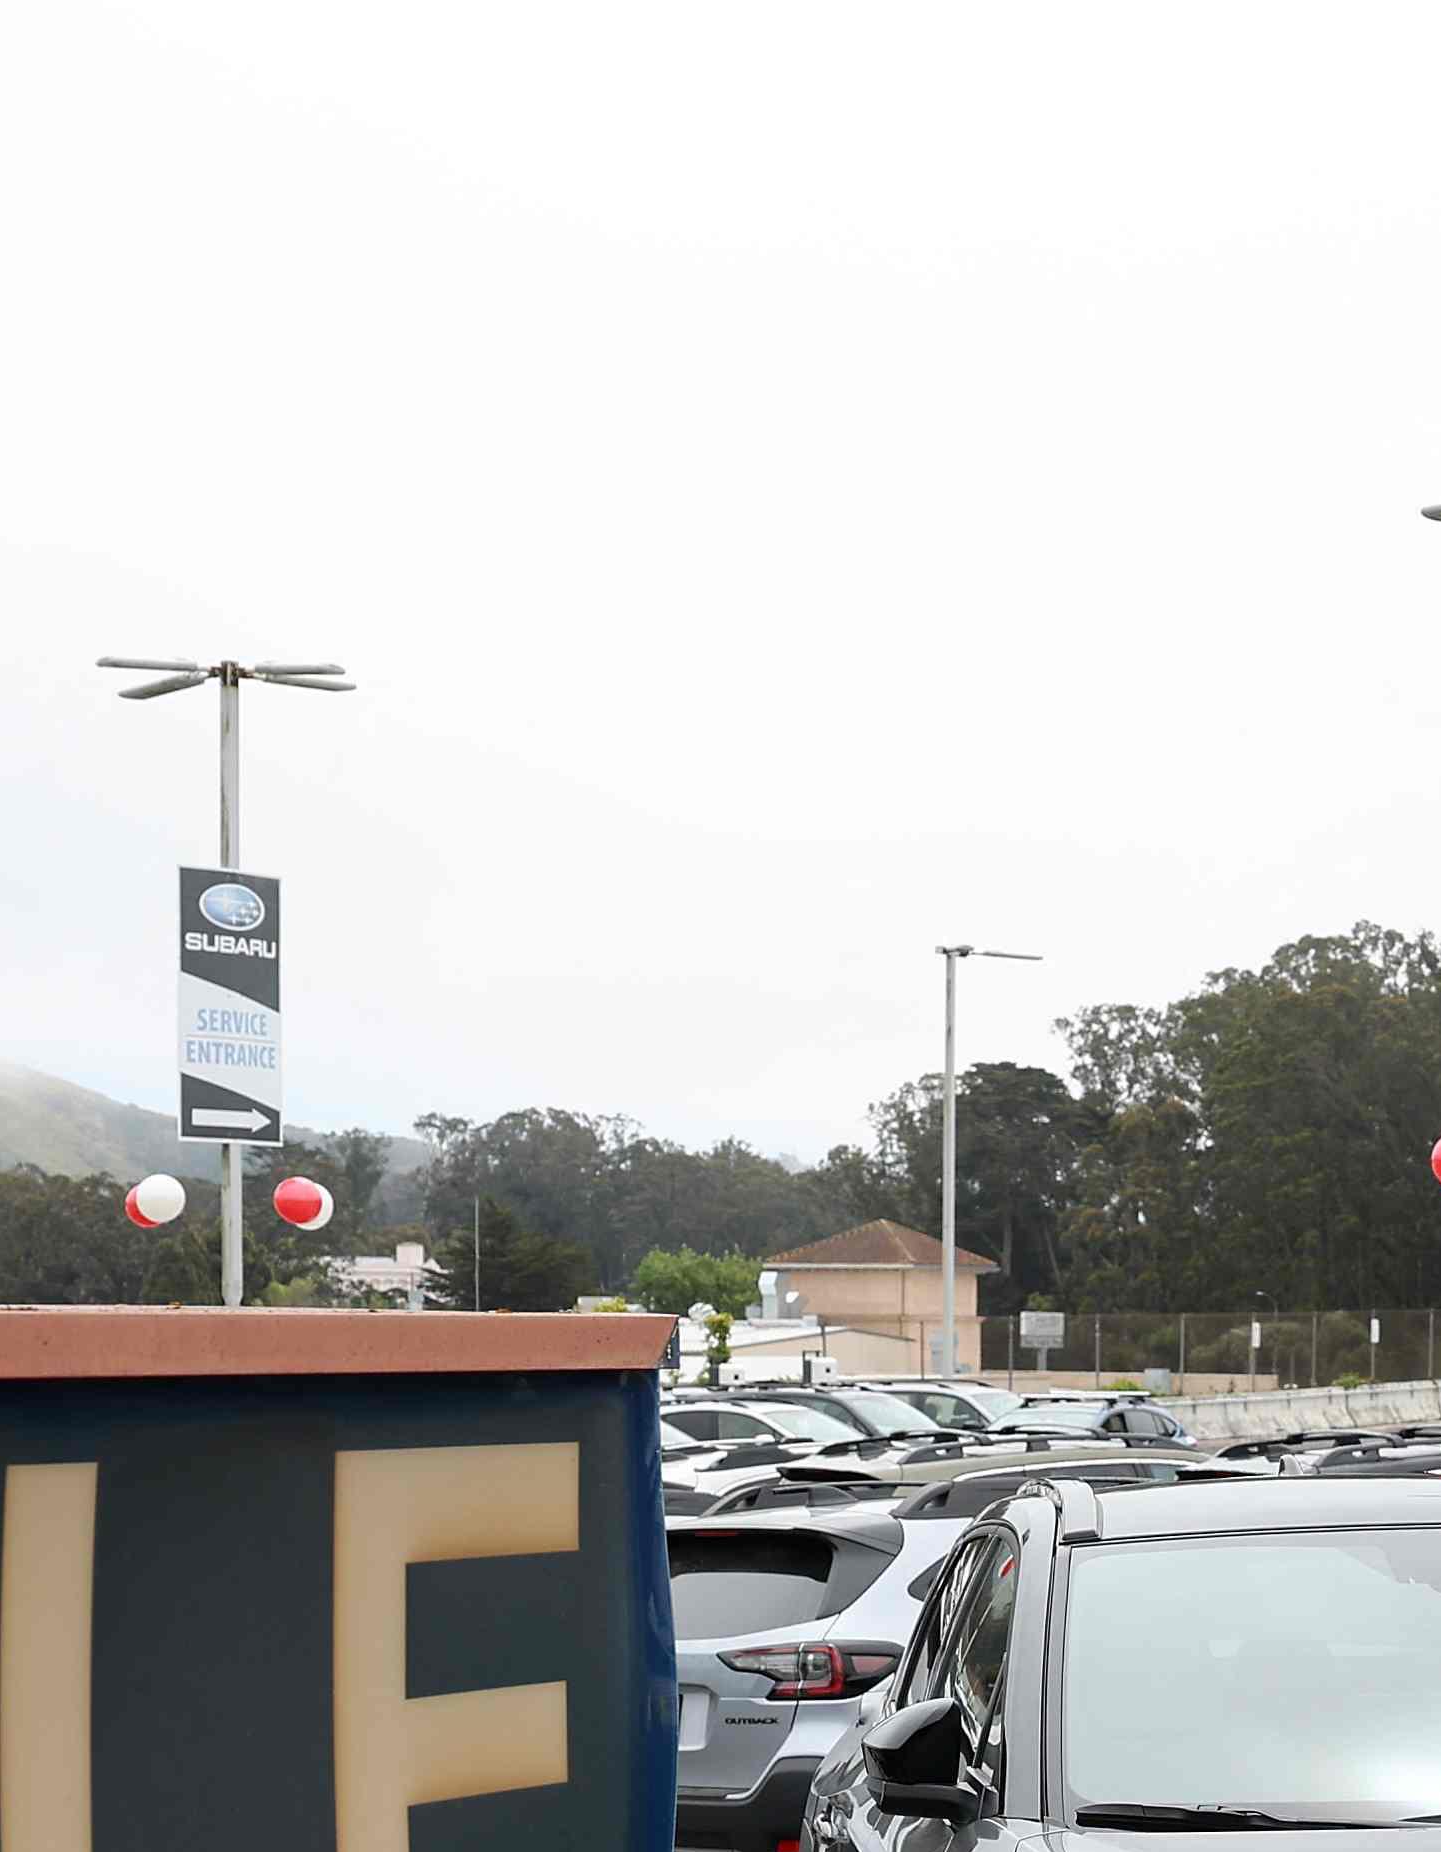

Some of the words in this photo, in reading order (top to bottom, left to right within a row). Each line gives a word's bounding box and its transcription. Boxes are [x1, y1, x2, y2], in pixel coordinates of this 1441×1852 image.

[184, 932, 277, 959] SUBARU
[196, 1008, 268, 1036] SERVICE
[185, 1040, 277, 1069] ENTRANCE
